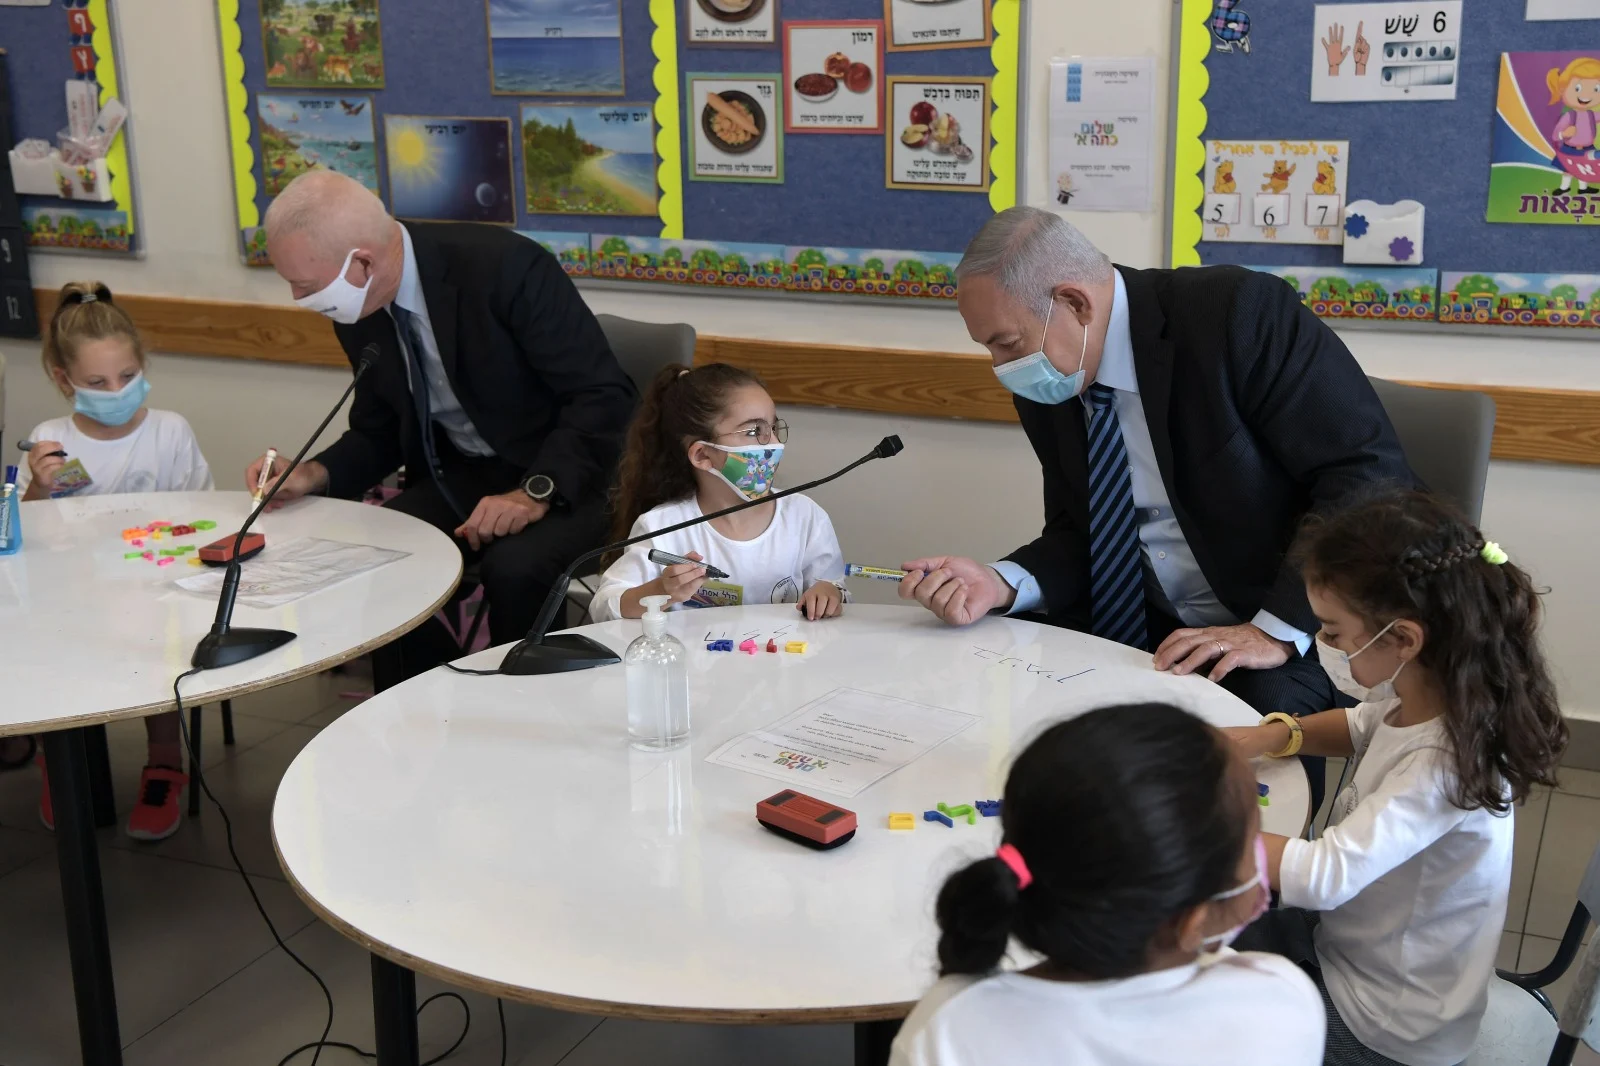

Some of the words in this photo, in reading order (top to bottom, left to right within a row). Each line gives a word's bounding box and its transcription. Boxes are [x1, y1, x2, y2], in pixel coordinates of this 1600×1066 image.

[1433, 11, 1446, 33] 6
[599, 111, 628, 122] שלישי
[632, 112, 647, 121] יום
[1081, 120, 1114, 134] שלום
[1091, 135, 1118, 146] כתה
[1259, 144, 1275, 155] מי
[1322, 144, 1339, 156] מי
[1211, 203, 1224, 222] 5
[1263, 206, 1275, 226] 6
[1317, 205, 1328, 225] 7
